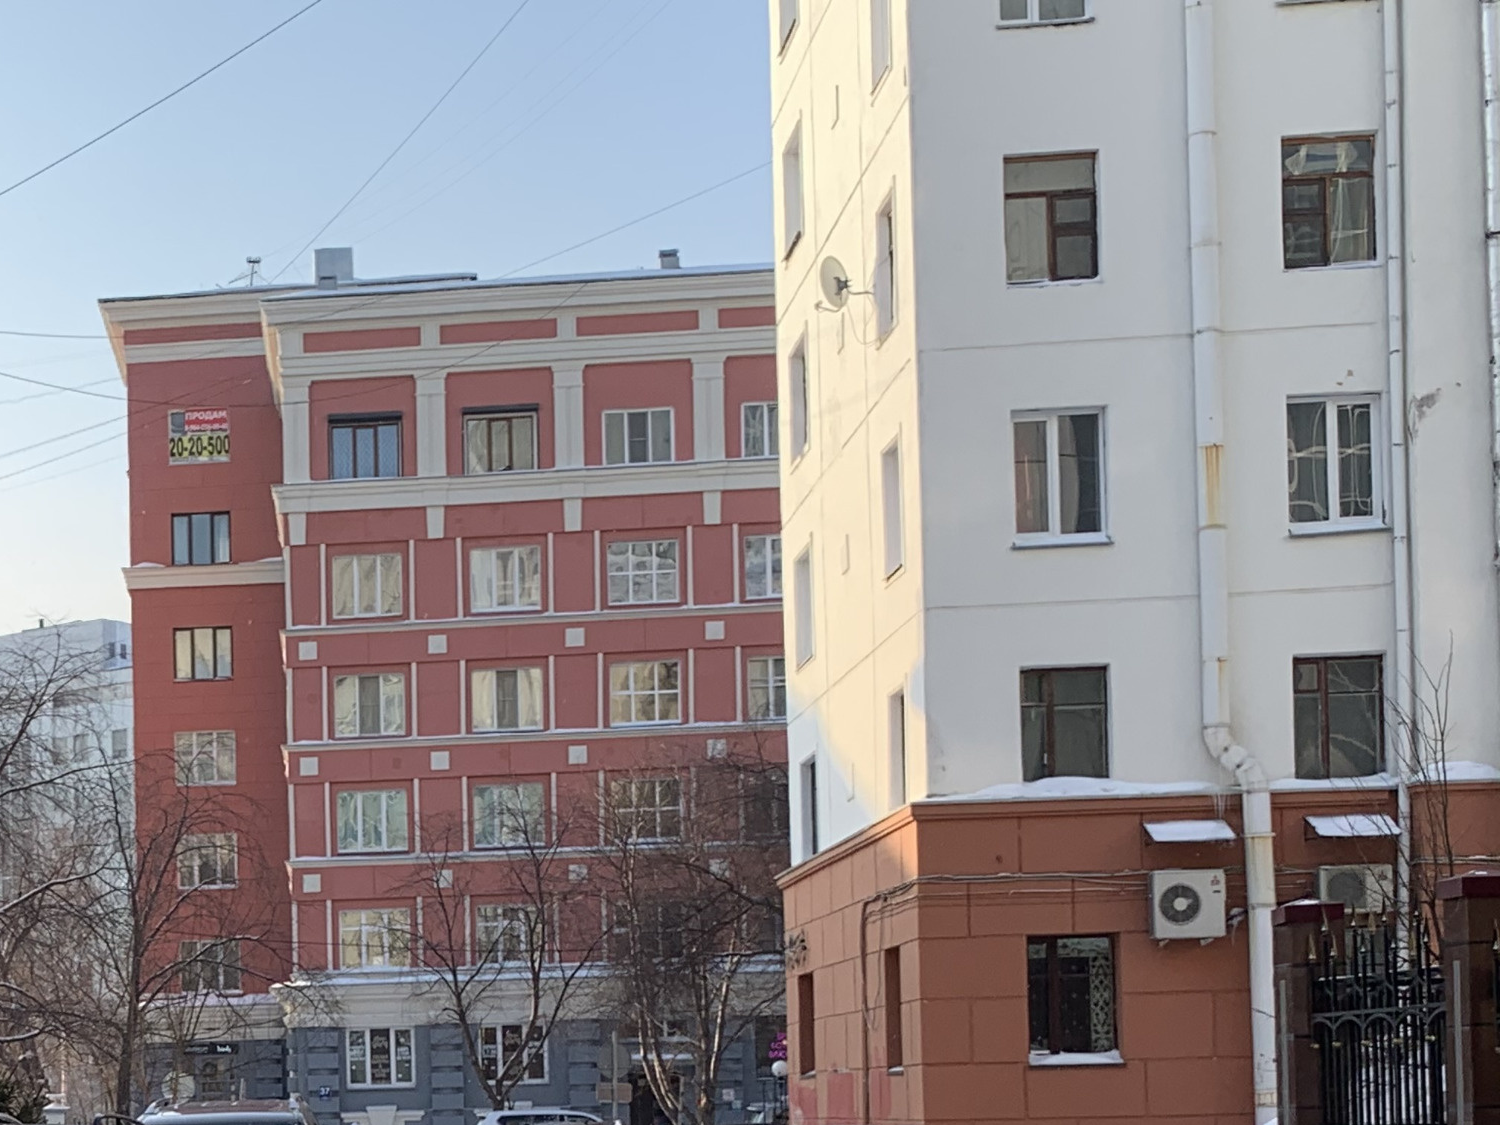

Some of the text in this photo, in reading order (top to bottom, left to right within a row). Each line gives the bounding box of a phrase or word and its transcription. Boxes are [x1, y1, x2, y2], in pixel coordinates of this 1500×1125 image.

[185, 410, 228, 420] ПРОДАМ
[169, 435, 230, 457] 20-20-500
[319, 1087, 330, 1095] 37
